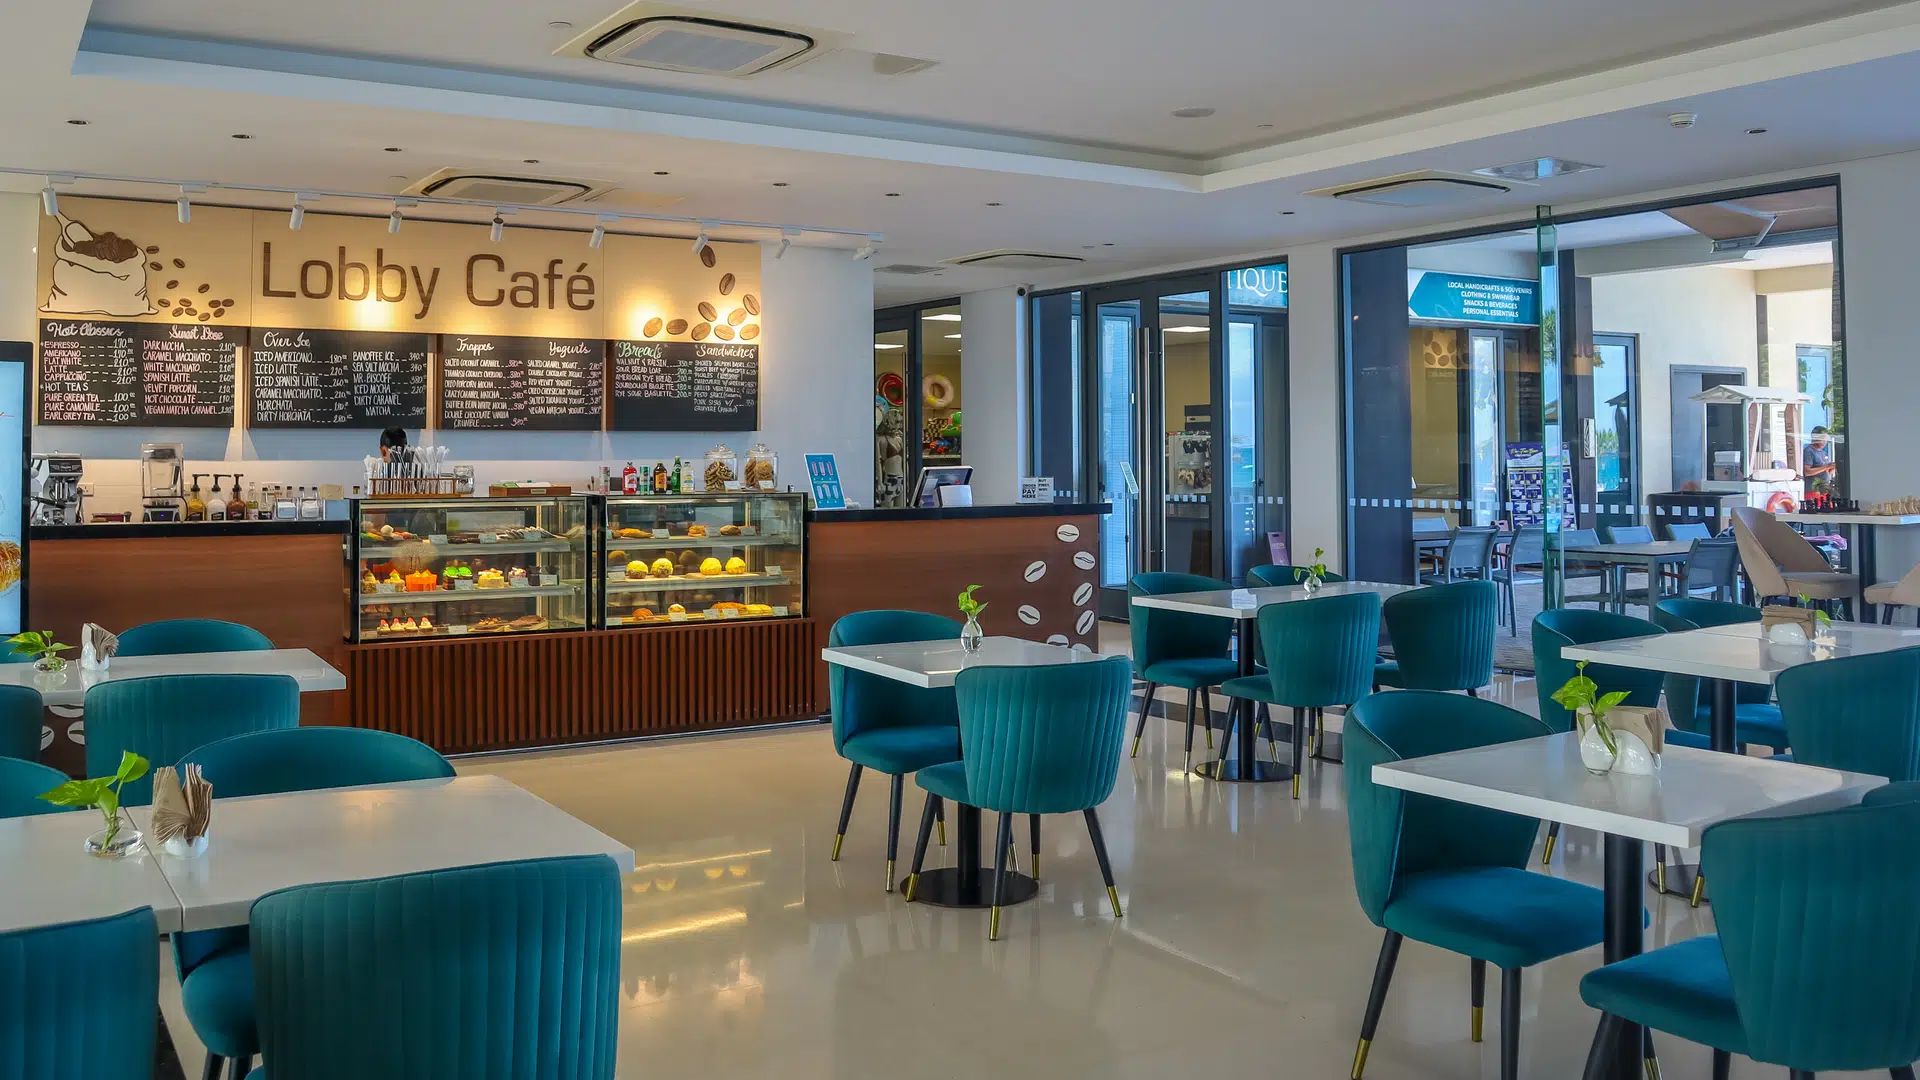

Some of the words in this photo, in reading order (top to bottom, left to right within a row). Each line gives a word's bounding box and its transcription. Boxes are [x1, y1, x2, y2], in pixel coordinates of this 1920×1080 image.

[262, 241, 440, 319] Lobby
[466, 253, 595, 311] Café
[1465, 283, 1499, 291] HANDICRAFTS
[1505, 286, 1532, 294] SOUVENIRS
[1463, 308, 1489, 316] PERSONAL
[1490, 310, 1519, 318] ESSENTIALS
[47, 322, 78, 337] Hot
[80, 323, 124, 336] Classics
[200, 326, 224, 340] Dose
[263, 331, 292, 347] Over
[44, 341, 80, 349] ESPRESSO
[143, 340, 160, 350] DARK
[161, 341, 185, 351] MOCHA
[549, 341, 591, 358] Yogurts
[143, 351, 173, 361] CARAMEL
[254, 352, 273, 361] ICED
[274, 352, 312, 363] AMERICANO
[385, 351, 395, 361] ICE
[44, 365, 67, 373] LATTE
[143, 362, 164, 372] WHITE
[255, 363, 274, 374] ICED
[276, 364, 298, 374] LATTE
[352, 362, 364, 372] SEA
[365, 363, 378, 372] SALT
[44, 373, 87, 381] CAPPUCCINO
[143, 373, 169, 382] SPANISH
[171, 373, 190, 382] LATTE
[255, 376, 274, 387] ICED
[275, 376, 300, 387] SPANISH
[302, 376, 319, 387] LATTE
[45, 382, 61, 391] HOT
[65, 382, 88, 391] TEAS
[143, 383, 168, 393] VELVET
[354, 385, 369, 394] ICED
[44, 393, 62, 401] PURE
[64, 393, 85, 402] GREEN
[86, 394, 99, 402] TEA
[255, 388, 282, 399] CARAMEL
[145, 395, 159, 403] HOT
[159, 395, 196, 404] CHOCOLATE
[354, 396, 371, 405] DIRTY
[45, 402, 64, 411] PURE
[66, 403, 100, 411] CAMOMILE
[145, 406, 166, 414] VEGAN
[257, 400, 293, 411] HORCHATA
[44, 412, 62, 420] EARL
[63, 412, 81, 420] GREY
[257, 411, 278, 421] DIRTY
